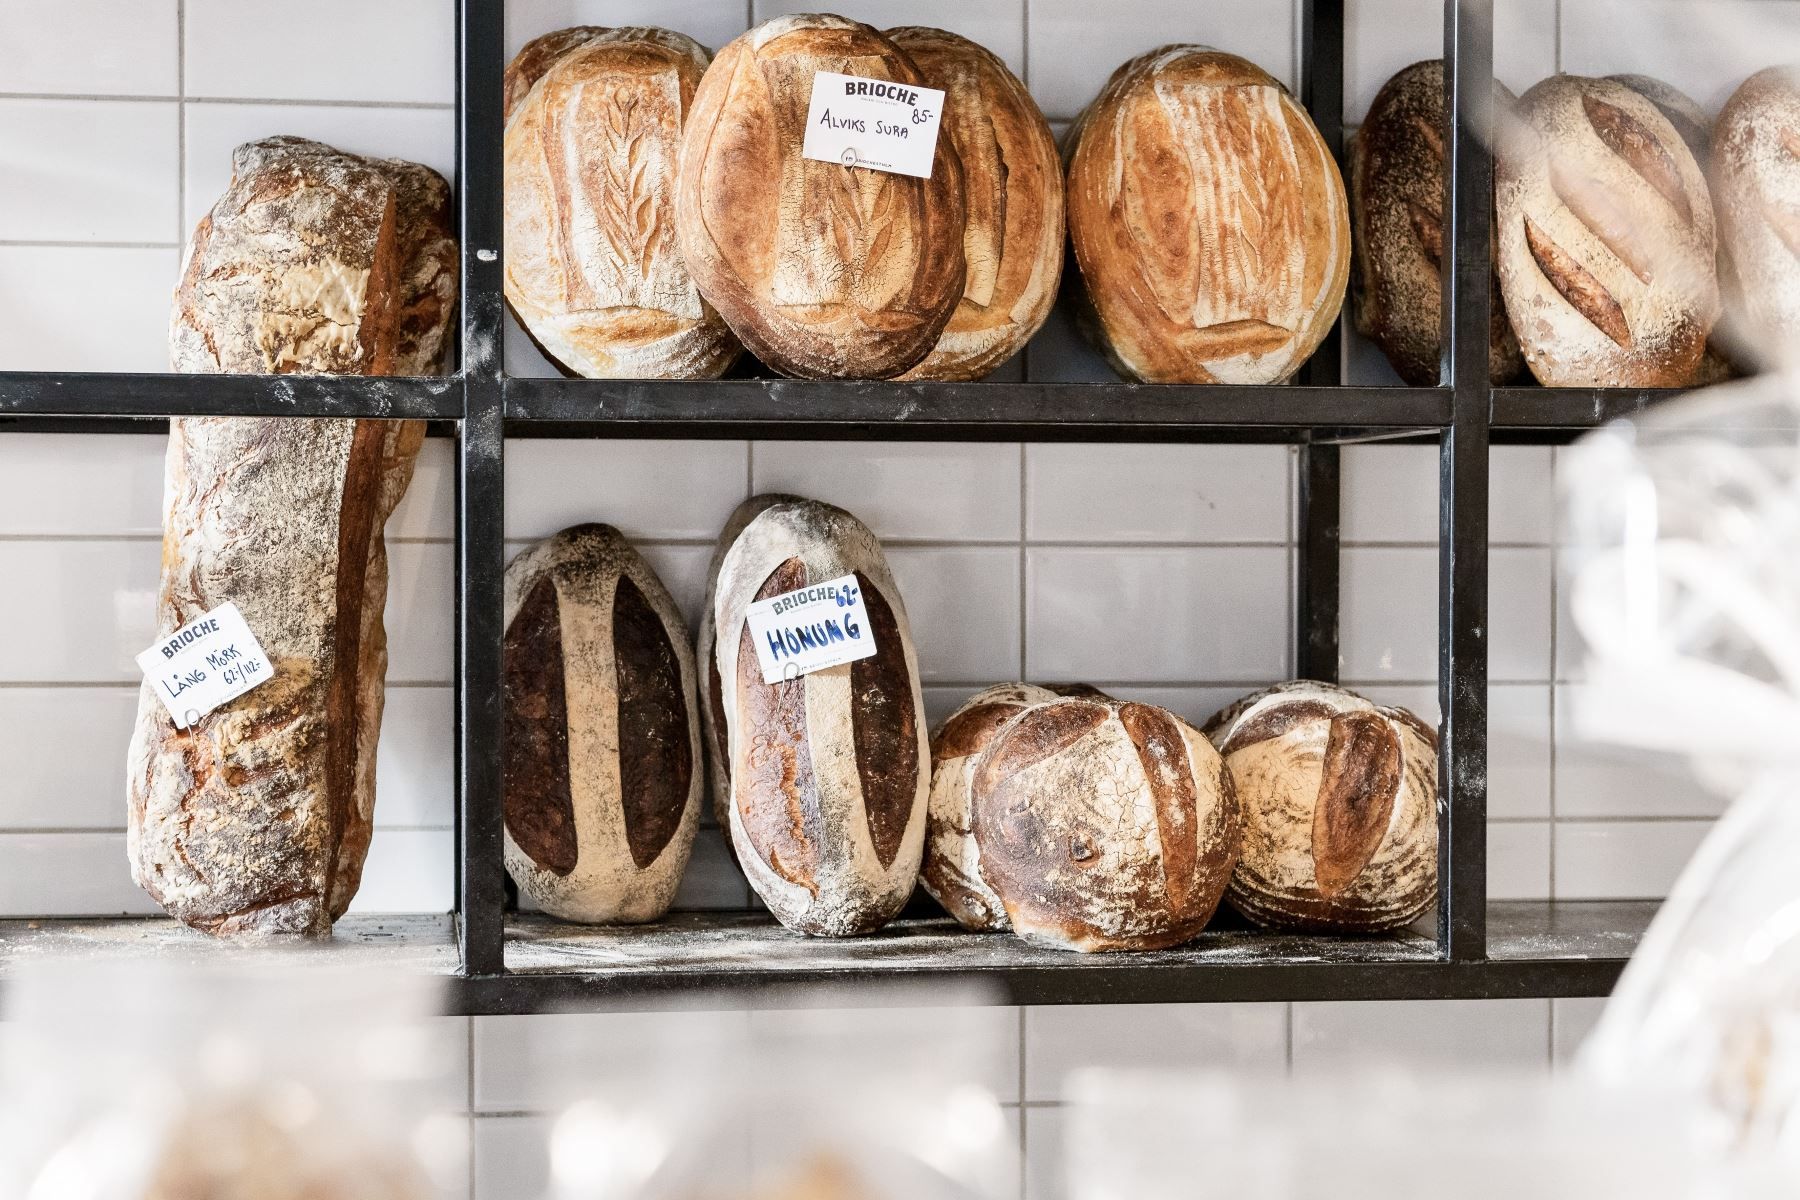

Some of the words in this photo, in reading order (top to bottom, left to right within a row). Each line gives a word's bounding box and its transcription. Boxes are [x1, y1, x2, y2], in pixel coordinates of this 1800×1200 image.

[845, 81, 919, 107] BRIOCHE
[820, 107, 866, 133] ALVIKS
[875, 120, 909, 139] SURA
[772, 586, 836, 616] BRIOCHE
[161, 618, 220, 660] BRIOCHE
[766, 612, 861, 661] HONUNG
[161, 669, 207, 698] LÅNG
[205, 643, 242, 671] MÖRK
